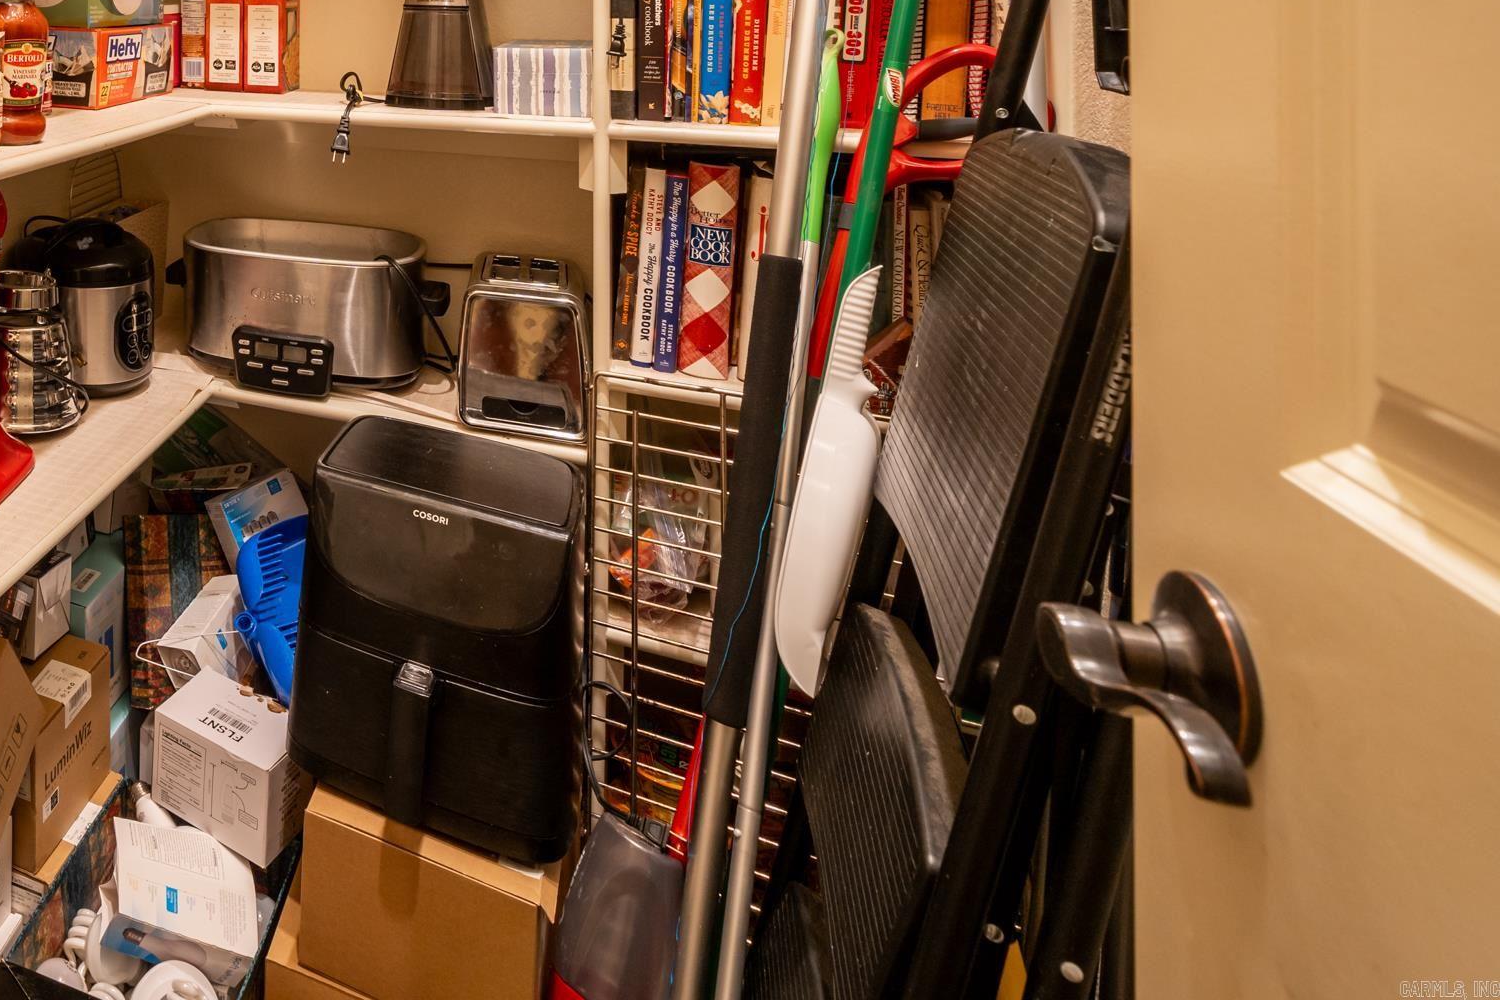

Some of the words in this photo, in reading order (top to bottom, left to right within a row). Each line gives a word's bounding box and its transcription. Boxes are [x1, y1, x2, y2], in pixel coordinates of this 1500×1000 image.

[644, 6, 654, 46] cookbook
[109, 37, 141, 58] Hefty
[752, 19, 760, 71] DINNERTIME
[845, 30, 863, 56] 300
[7, 53, 43, 63] BERTOLLI
[742, 30, 751, 80] DRUMMOND
[847, 70, 855, 83] Lisa
[887, 69, 901, 105] LIBMAN
[101, 85, 108, 97] 22
[846, 84, 854, 102] Lillien
[647, 188, 655, 210] KATHY
[673, 181, 682, 195] The
[630, 190, 642, 219] Smoke
[656, 194, 664, 215] STEVE
[668, 196, 682, 223] Happy
[630, 220, 639, 229] &
[645, 212, 654, 236] DOOCY
[654, 217, 662, 232] AND
[671, 223, 679, 231] in
[695, 226, 729, 242] NEW
[625, 230, 639, 257] SPICE
[648, 242, 656, 254] The
[666, 238, 679, 264] Hurry
[690, 236, 730, 253] COOK
[895, 229, 904, 255] NEW
[913, 225, 929, 254] Quick
[690, 248, 730, 264] BOOK
[917, 259, 929, 271] &
[643, 254, 657, 286] Happy
[250, 286, 317, 306] Cuisinart
[663, 265, 676, 314] COOKBOOK
[892, 257, 904, 322] COOKBOOK
[640, 287, 653, 342] COOKBOOK
[412, 508, 449, 526] COSORI
[198, 715, 245, 743] FLSNT
[44, 720, 93, 791] LuminWiz
